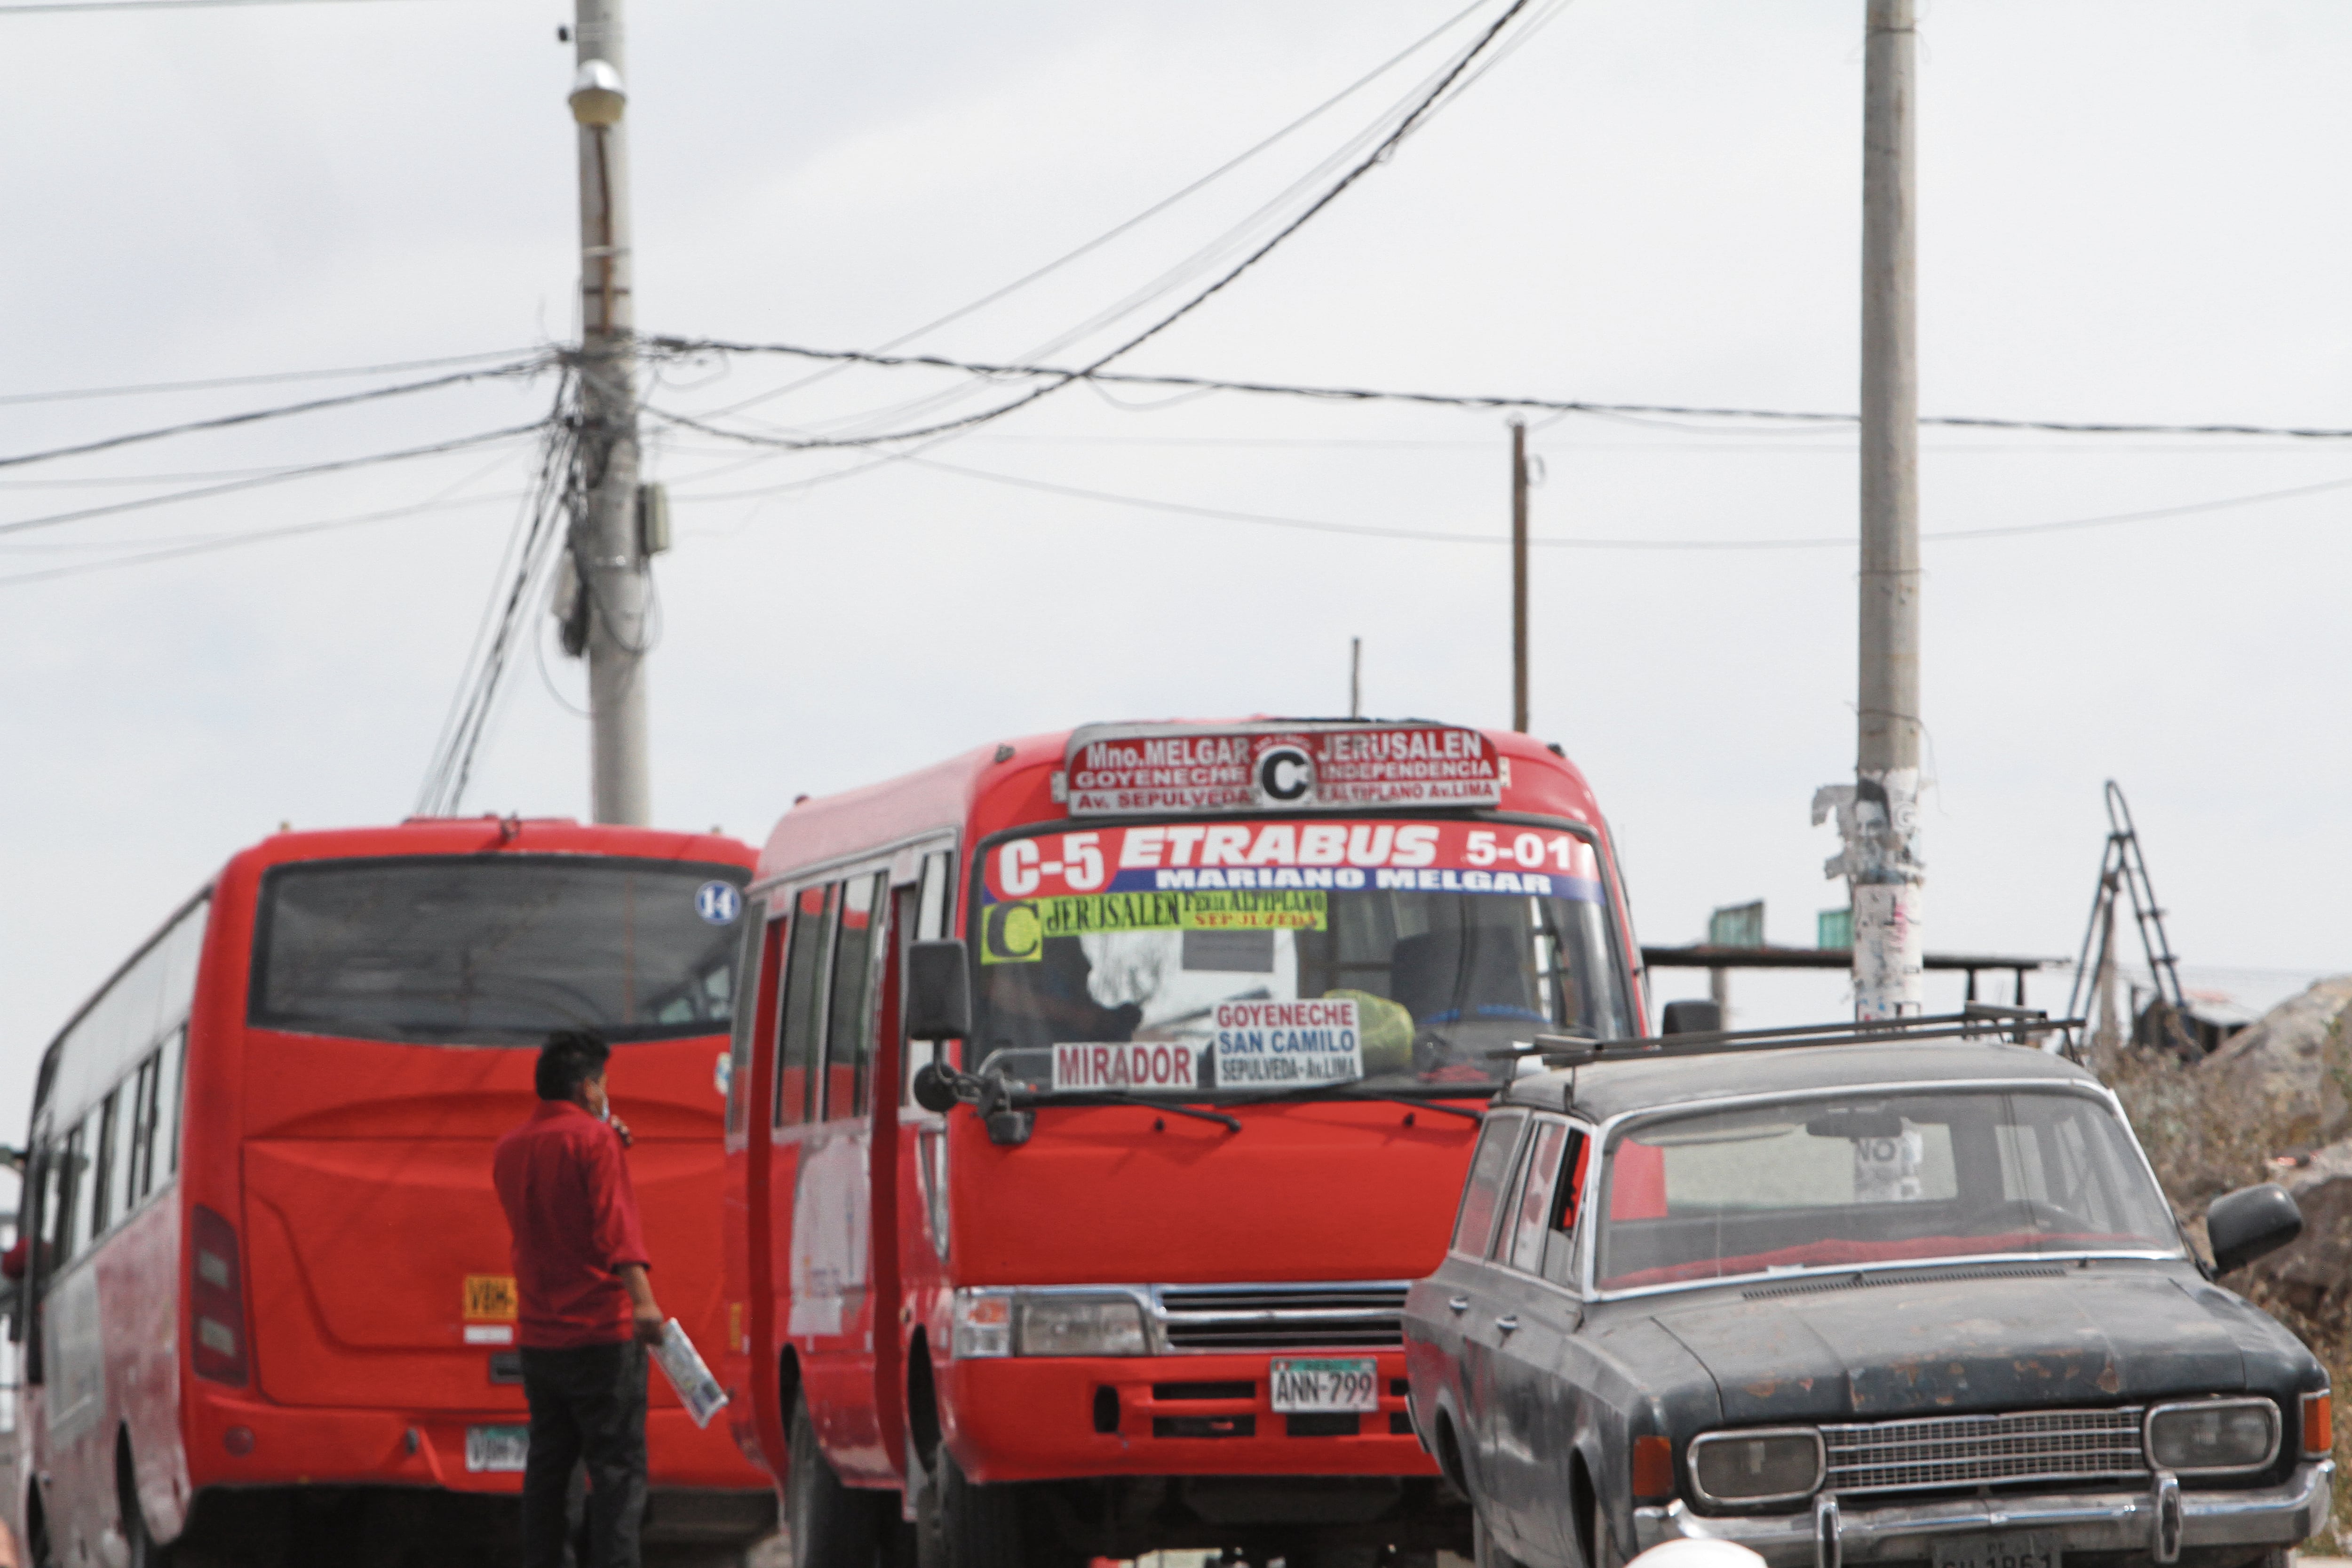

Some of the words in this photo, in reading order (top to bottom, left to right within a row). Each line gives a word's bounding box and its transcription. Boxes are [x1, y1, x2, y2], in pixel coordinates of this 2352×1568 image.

[1317, 731, 1483, 762] JERUSALEN
[1075, 765, 1247, 789] GOYENECHE
[1263, 751, 1308, 800] C
[1322, 759, 1494, 780] INDEPENDENCIA
[1118, 789, 1250, 808] SEPULVEDA
[1119, 825, 1440, 867] ETRABUS
[1466, 831, 1571, 870] 5-01
[1000, 832, 1104, 895] C-5
[1156, 868, 1365, 890] MARIANO
[1375, 868, 1552, 894] MELGAR
[988, 902, 1039, 957] C
[1218, 1003, 1354, 1027] GOYENECHE
[1220, 1031, 1263, 1054] SAN
[1271, 1028, 1355, 1052] CAMILO
[1059, 1045, 1192, 1085] MIRADOR
[1276, 1371, 1371, 1402] ANN-799
